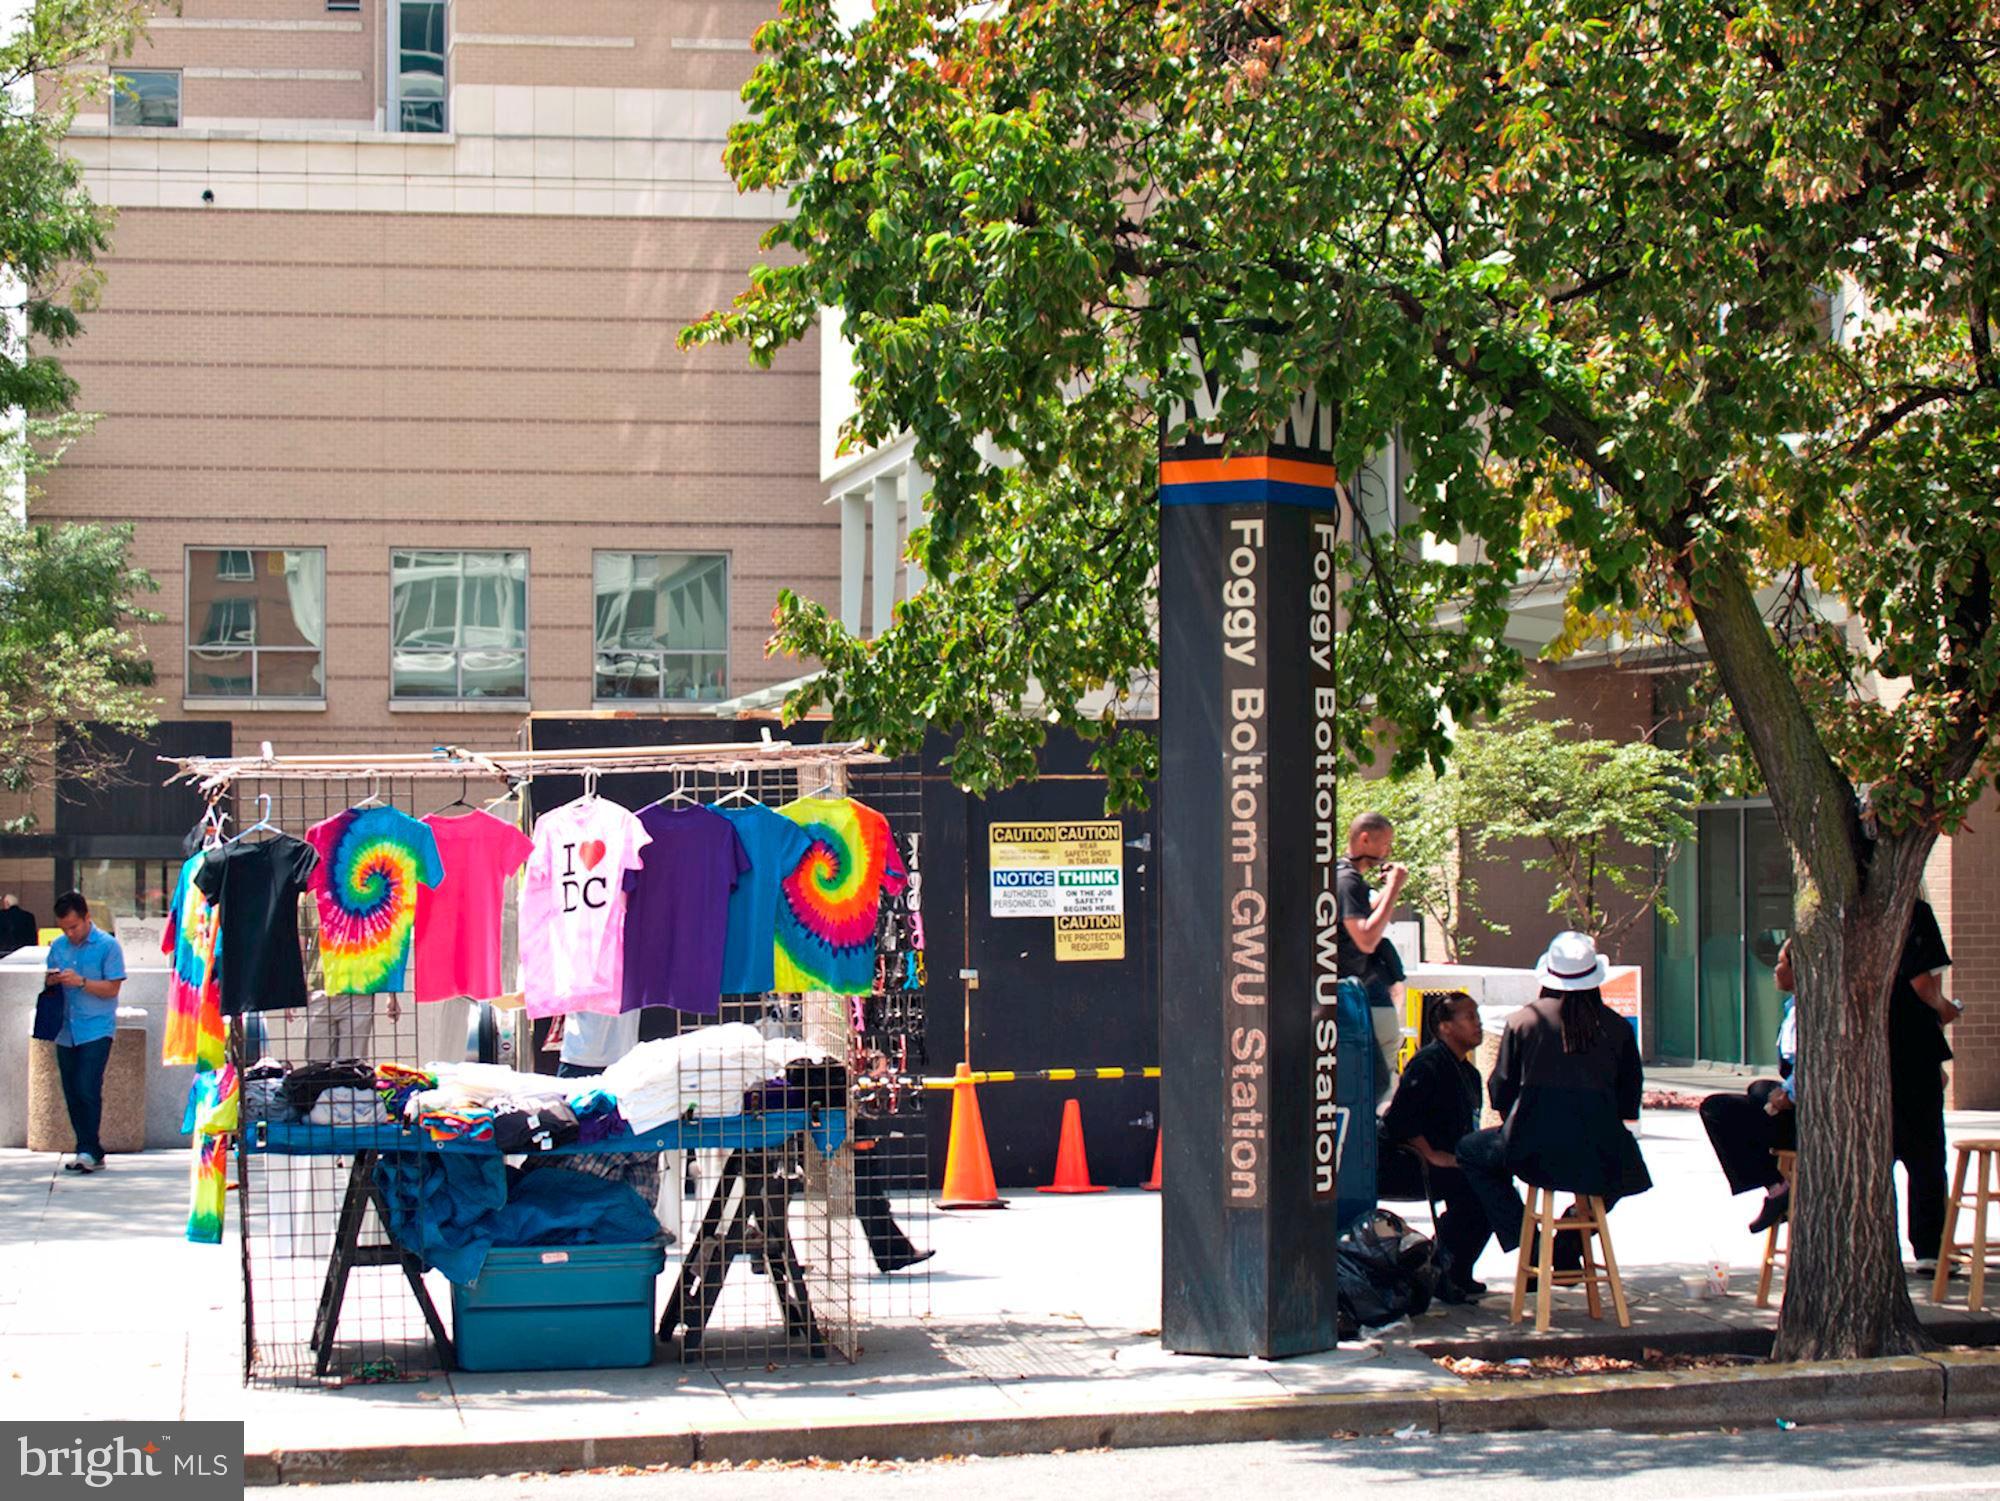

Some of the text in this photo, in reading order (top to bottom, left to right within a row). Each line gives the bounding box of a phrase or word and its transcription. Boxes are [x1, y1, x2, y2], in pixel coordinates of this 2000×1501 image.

[994, 828, 1055, 841] CAUTION
[1059, 826, 1119, 840] CAUTION
[563, 843, 575, 876] I
[1090, 849, 1112, 857] SHOES
[1223, 519, 1266, 1198] Foggy Bottom-GWU Station
[1310, 523, 1337, 1192] Foggy Bottom-GWU Station
[995, 872, 1054, 886] NOTICE
[1061, 871, 1117, 885] THINK
[562, 877, 606, 913] DC
[1003, 889, 1048, 898] AUTHORIZED
[993, 899, 1036, 908] PERSONNEL
[1059, 915, 1120, 929] CAUTION
[1058, 932, 1122, 942] EYE PROTECTION
[1071, 942, 1110, 951] REQUIRED
